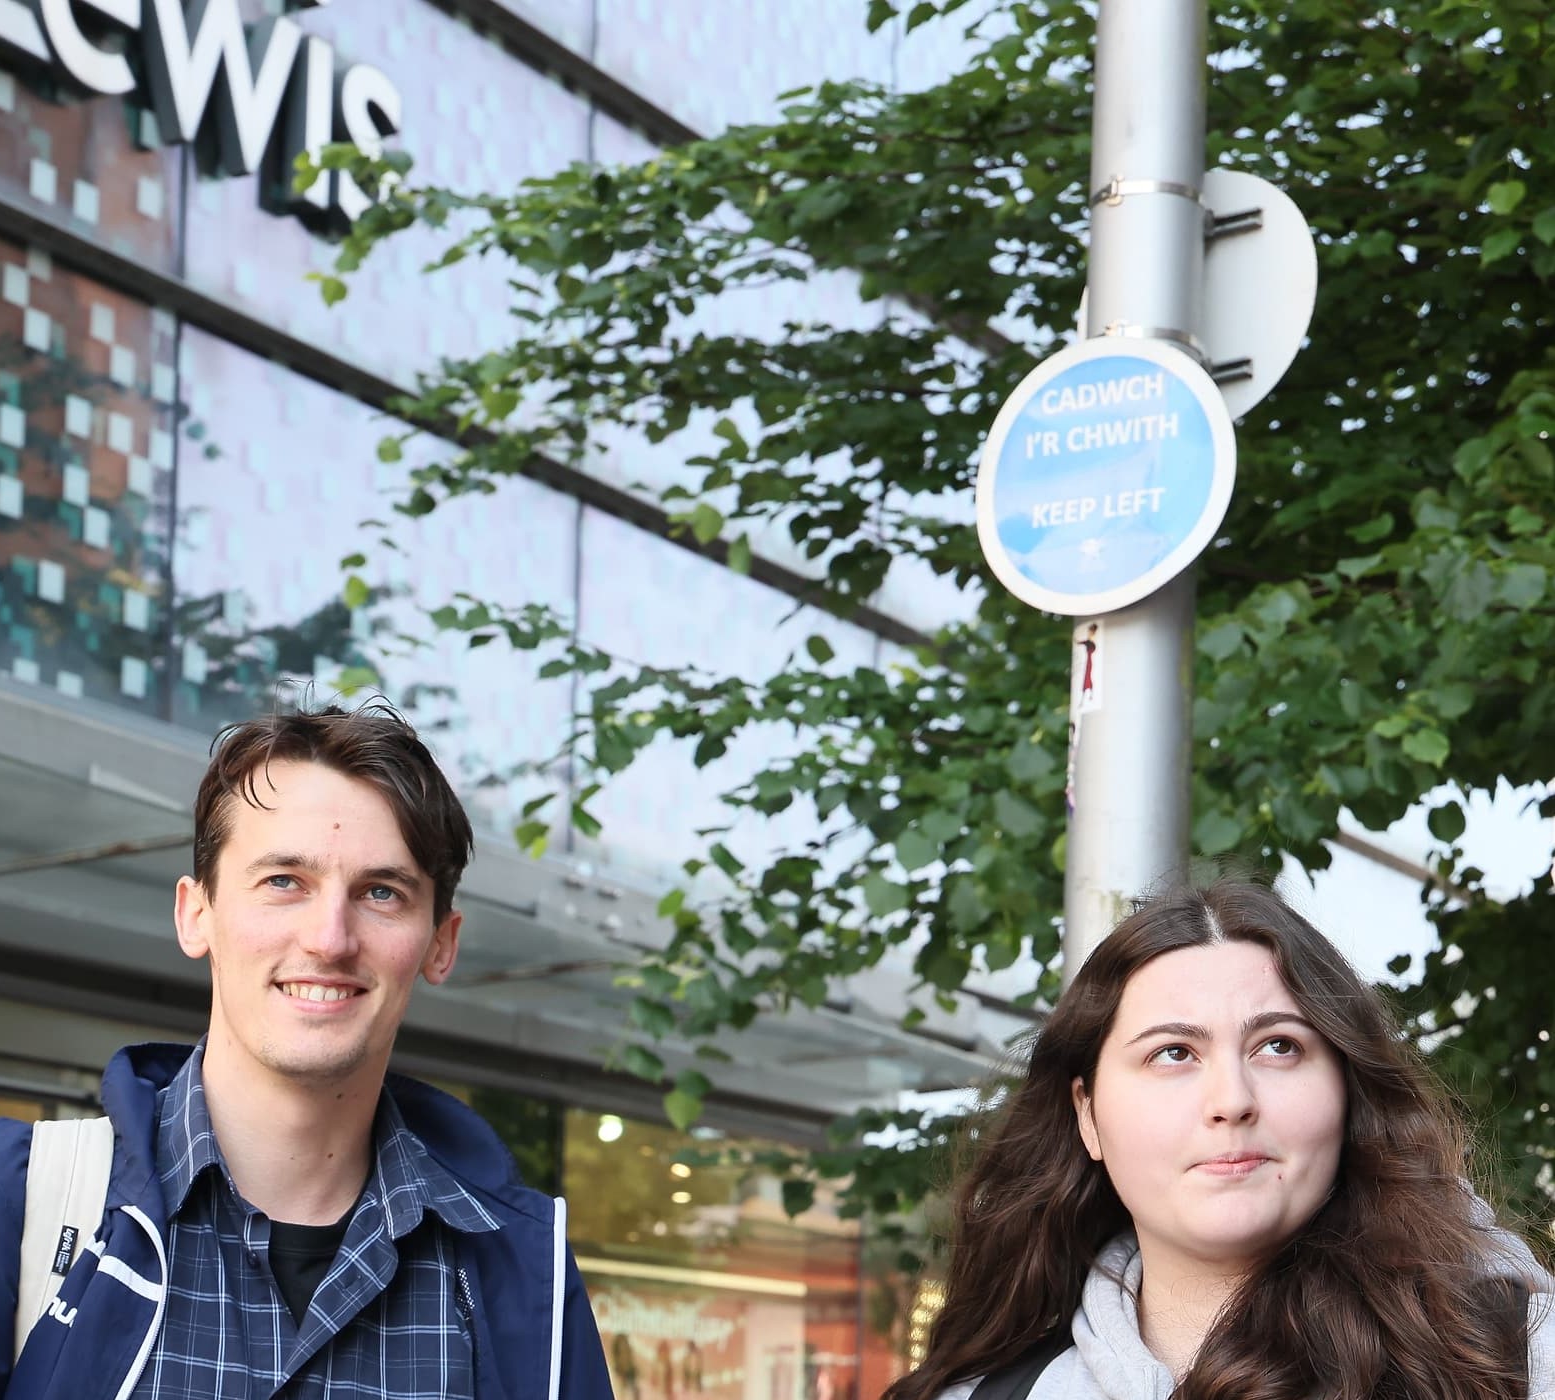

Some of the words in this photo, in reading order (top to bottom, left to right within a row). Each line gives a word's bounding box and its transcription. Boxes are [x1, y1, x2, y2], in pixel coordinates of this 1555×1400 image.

[1043, 372, 1164, 414] CADWCH
[1067, 413, 1178, 451] CHWITH
[1033, 498, 1095, 528] KEEP
[1103, 488, 1166, 518] LEFT
